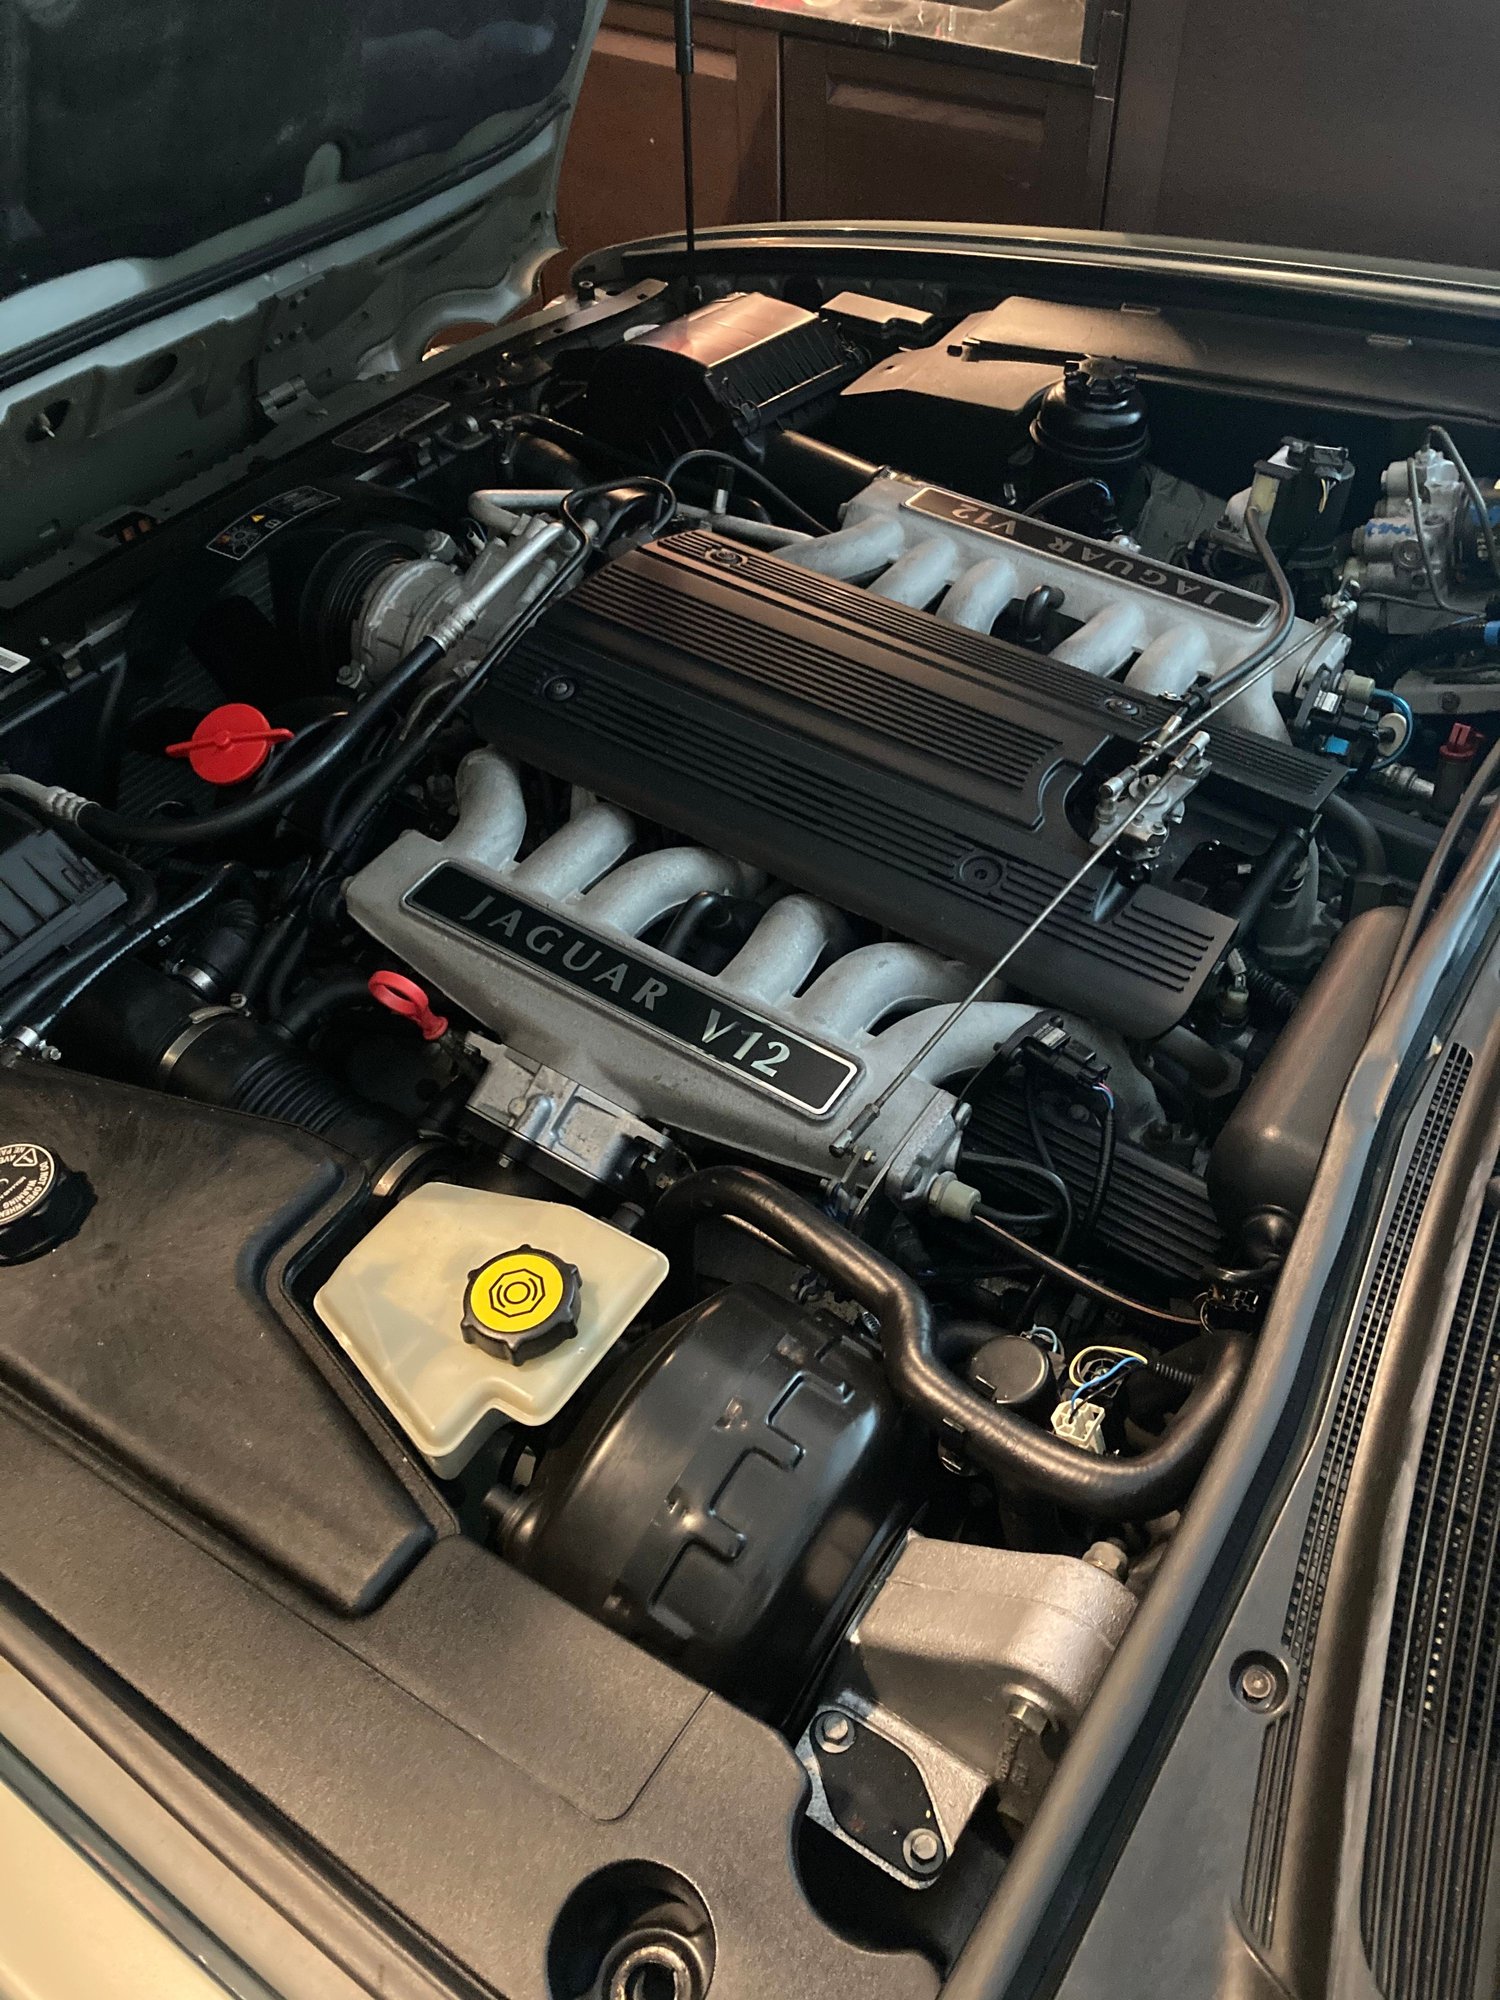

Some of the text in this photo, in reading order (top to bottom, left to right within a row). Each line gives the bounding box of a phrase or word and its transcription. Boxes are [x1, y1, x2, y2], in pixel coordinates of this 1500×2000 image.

[951, 503, 1222, 606] JAGUAR V12
[460, 894, 792, 1078] JAGUAR V12
[0, 1148, 12, 1156] PA
[37, 1171, 49, 1186] NOT
[2, 1179, 38, 1209] WARNING
[22, 1186, 43, 1205] OPEN
